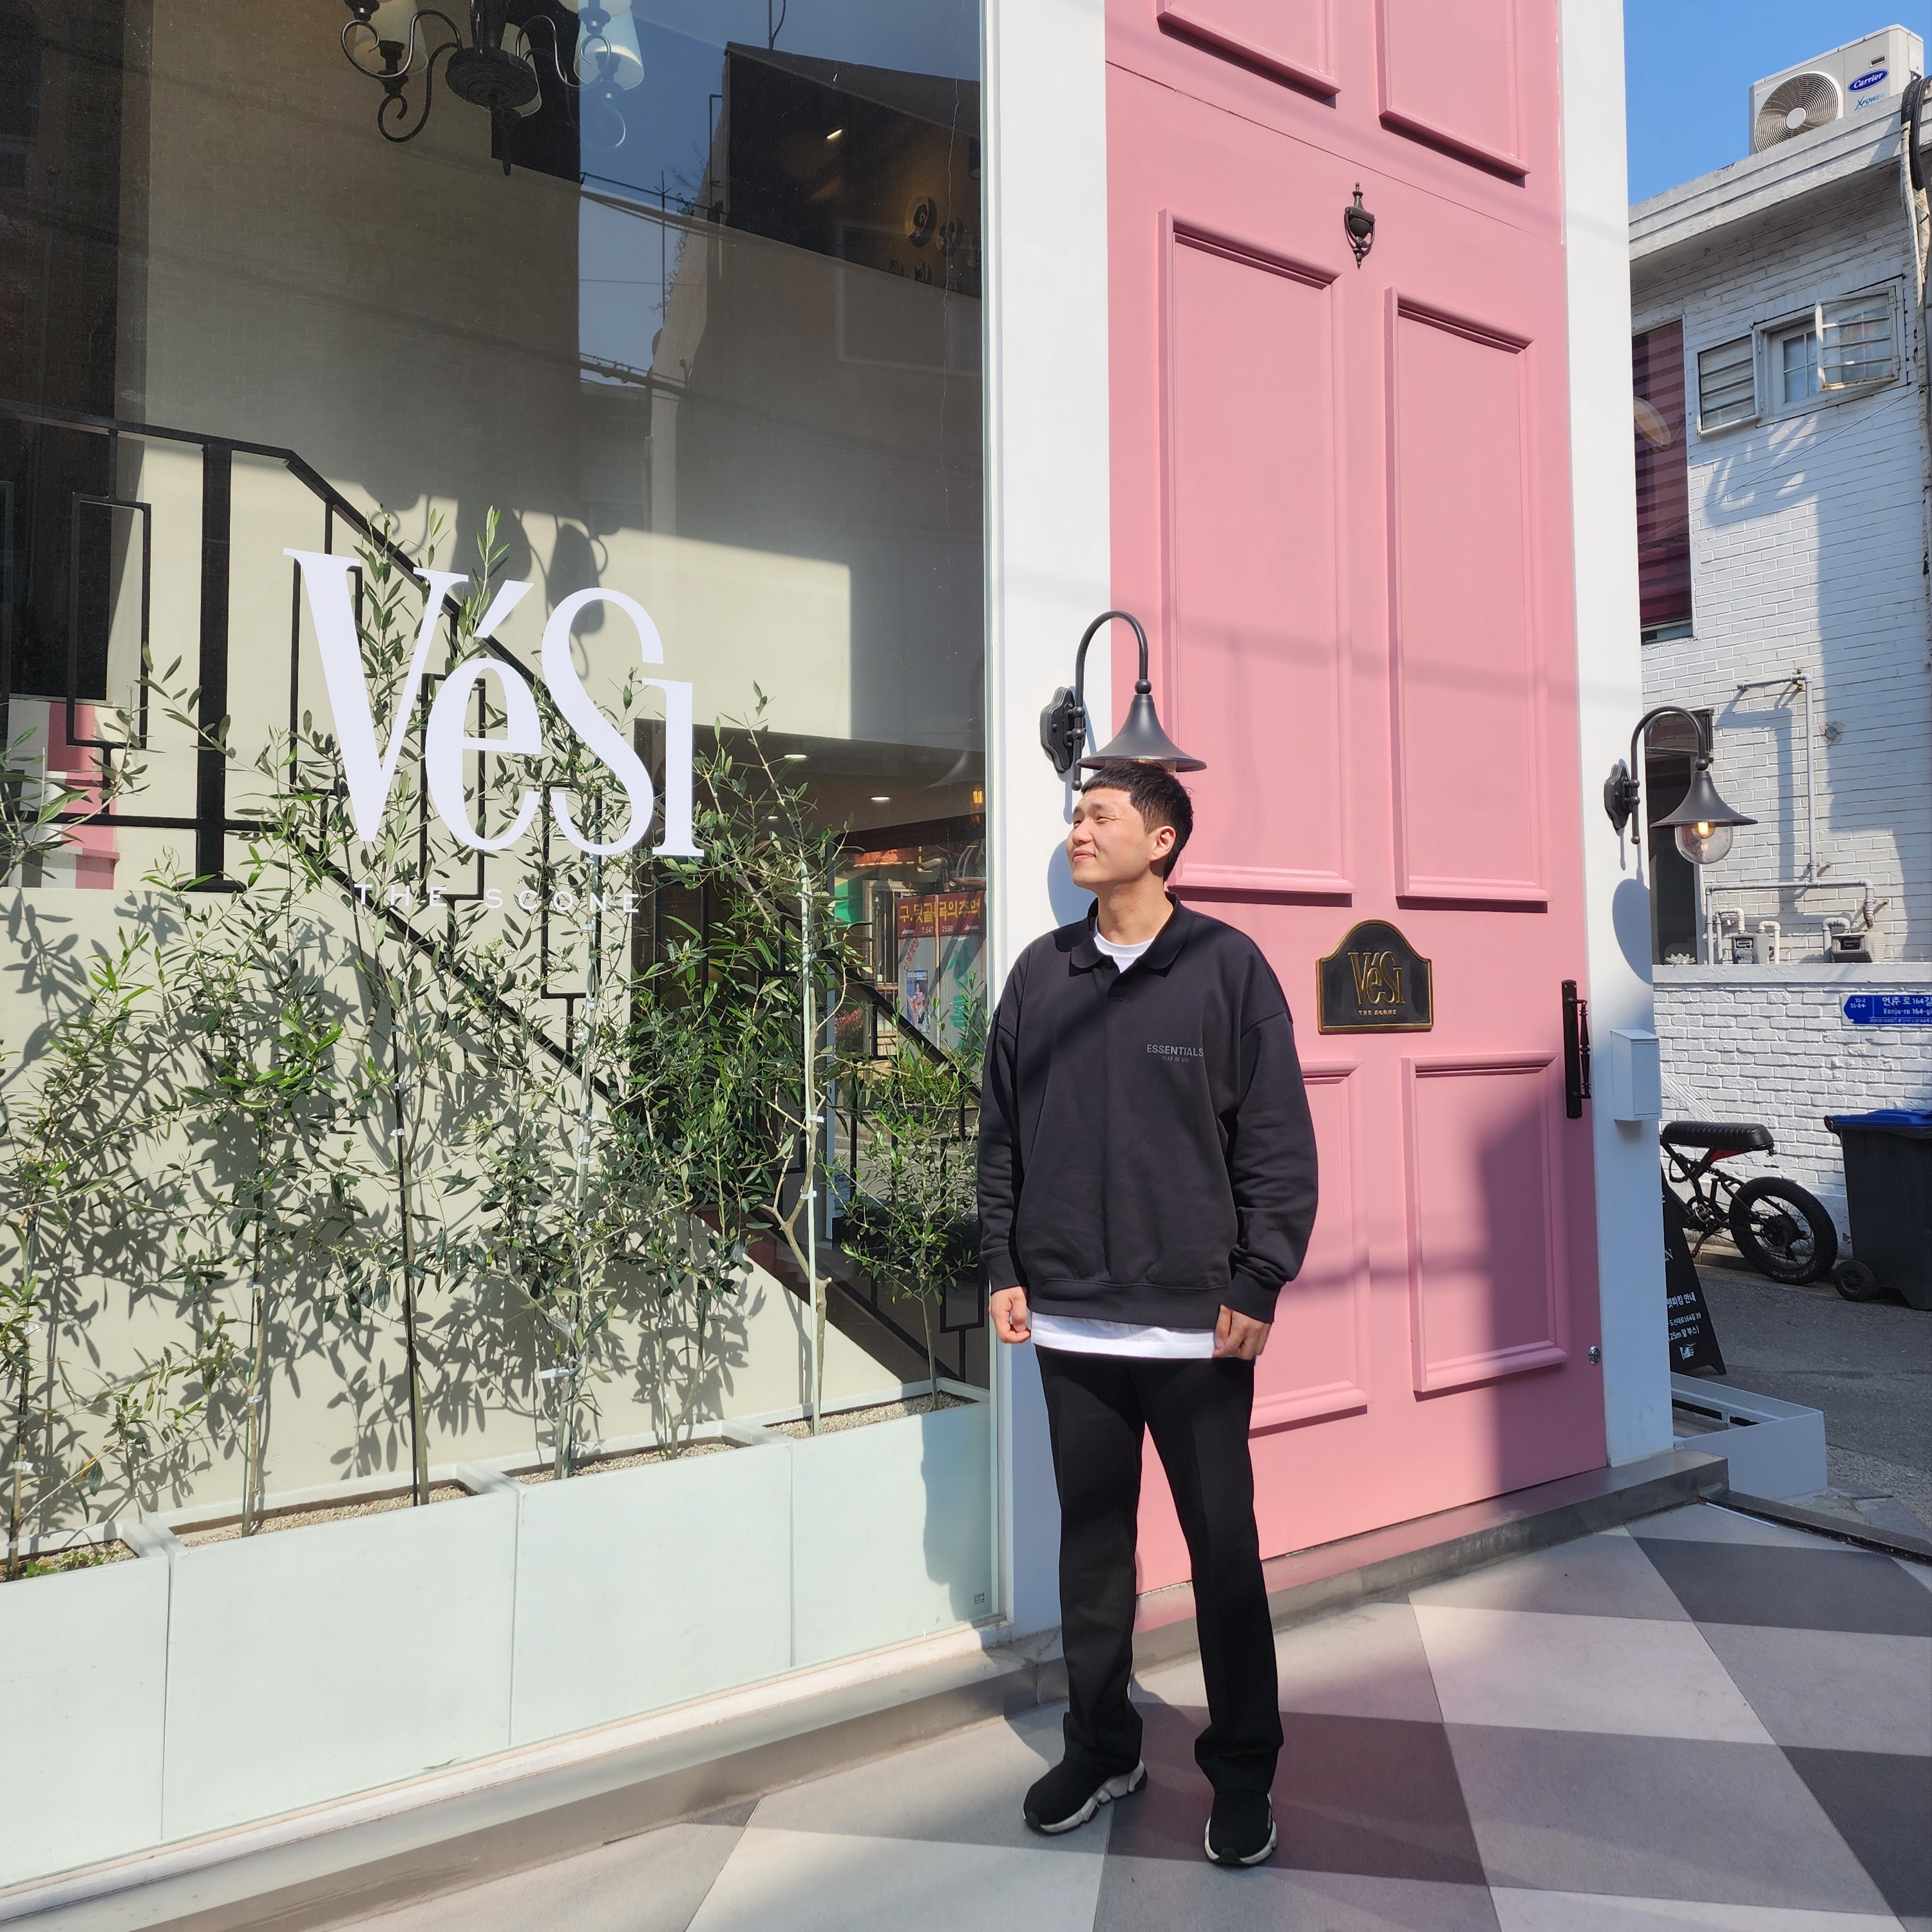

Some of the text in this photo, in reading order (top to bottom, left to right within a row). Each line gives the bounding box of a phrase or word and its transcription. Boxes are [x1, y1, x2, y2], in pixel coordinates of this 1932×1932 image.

[1853, 72, 1884, 89] Carrier
[354, 884, 639, 913] THE SCONE
[1146, 1044, 1204, 1057] ESSENTIALS
[1683, 1291, 1696, 1304] 안내
